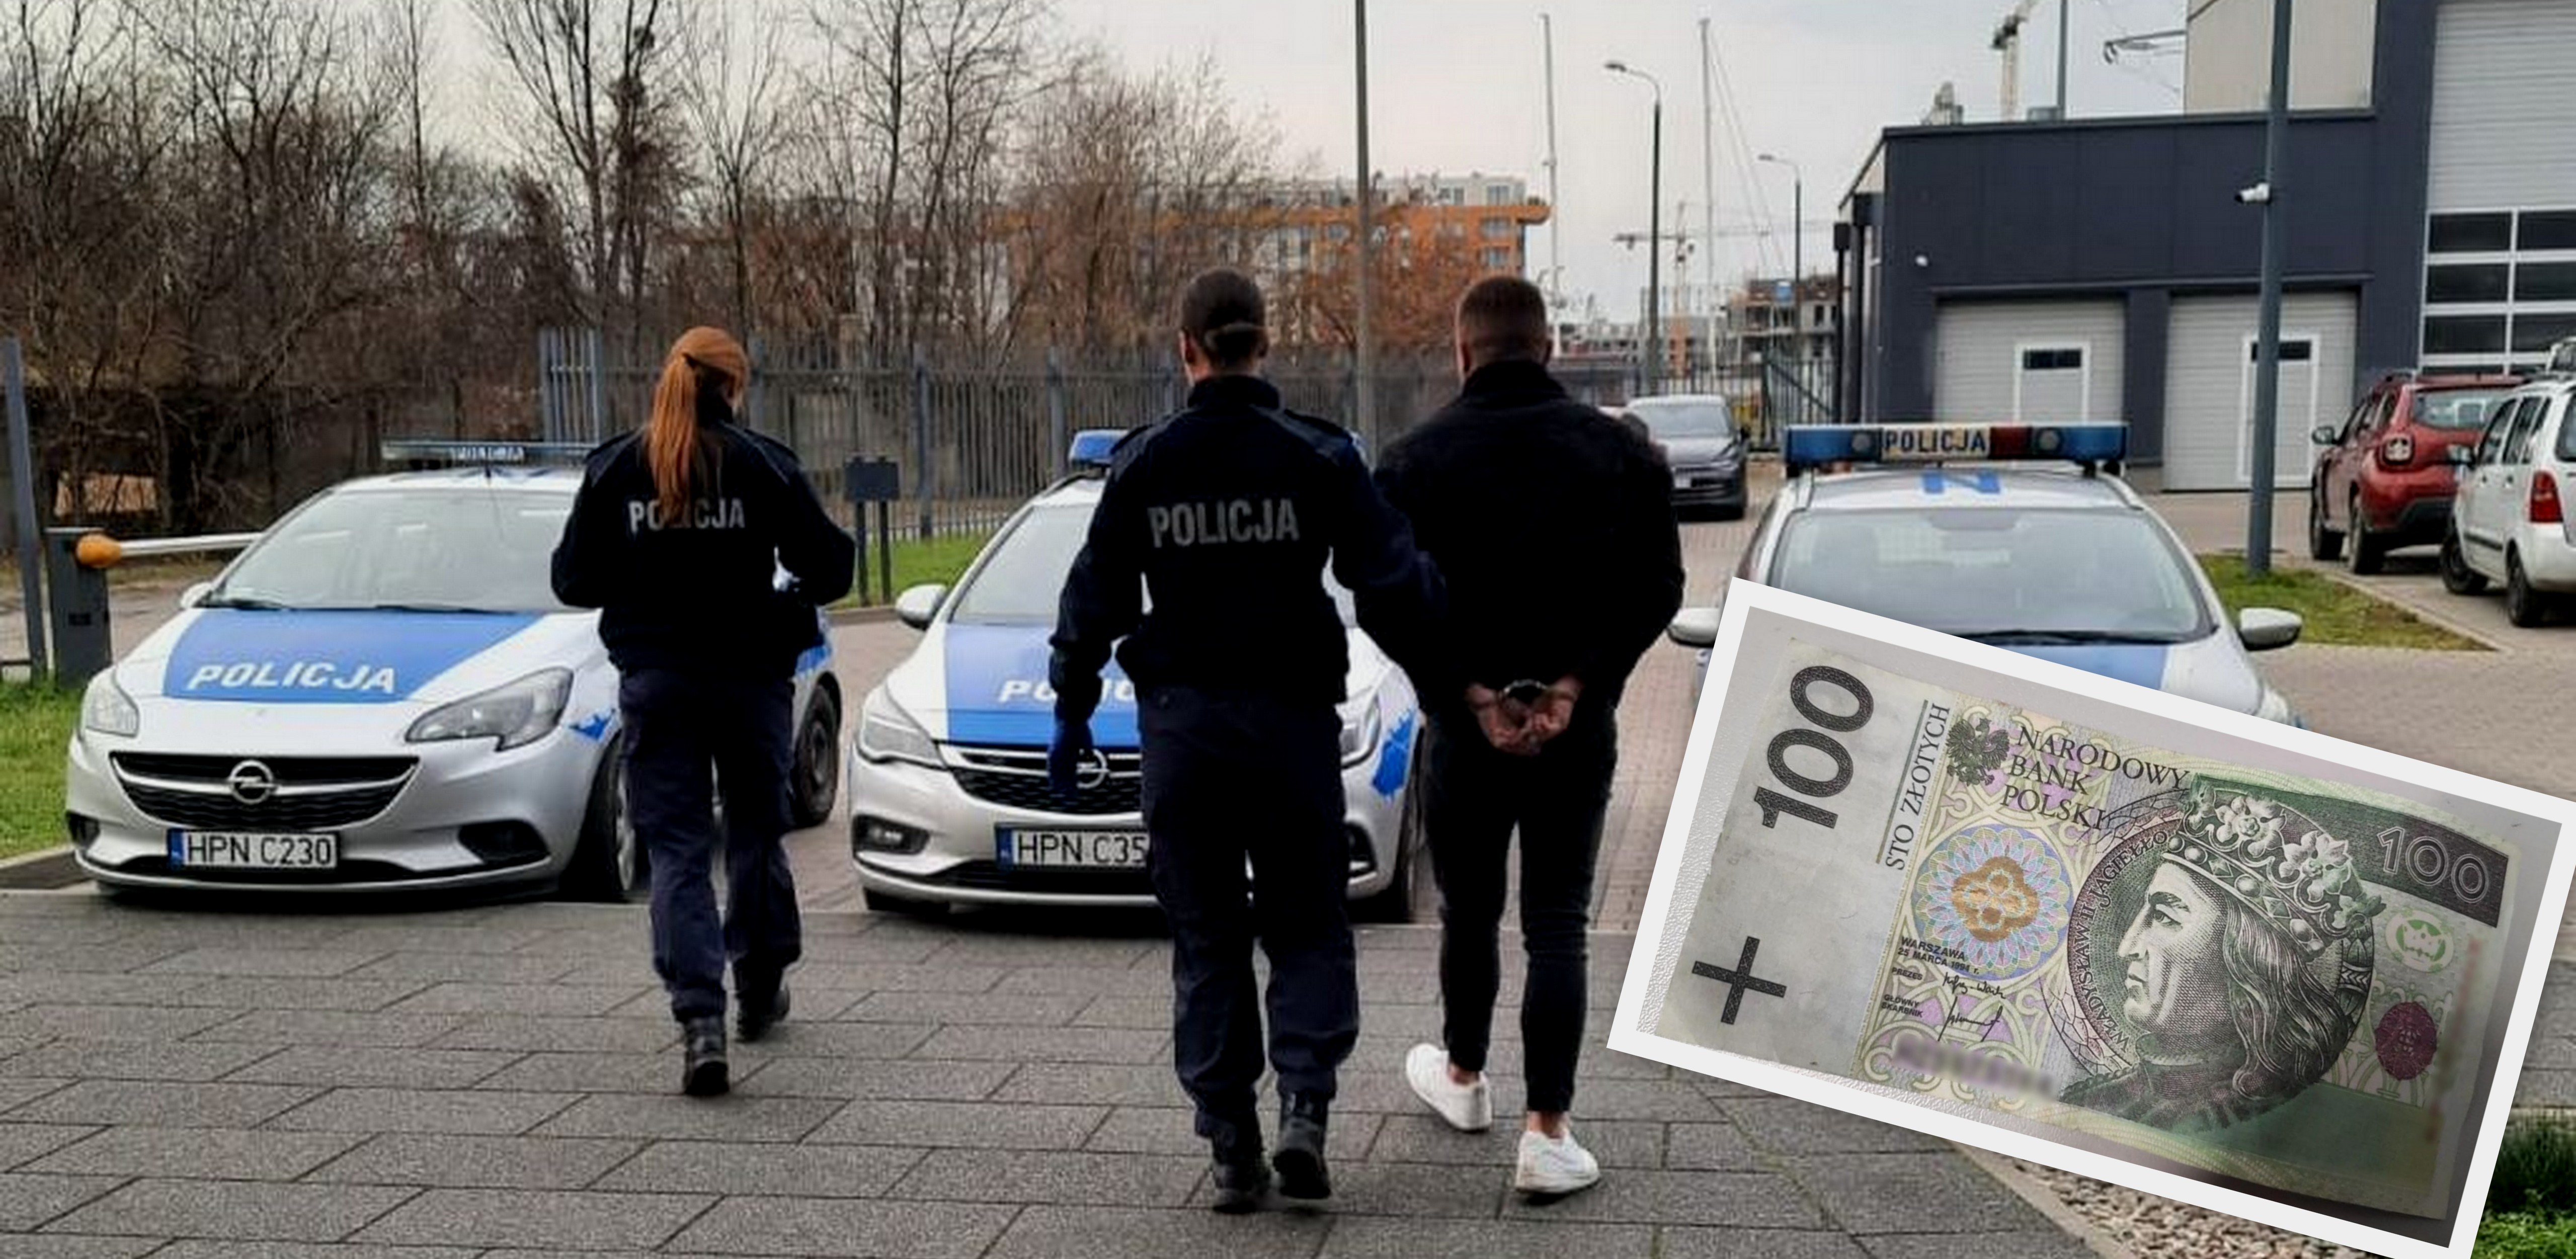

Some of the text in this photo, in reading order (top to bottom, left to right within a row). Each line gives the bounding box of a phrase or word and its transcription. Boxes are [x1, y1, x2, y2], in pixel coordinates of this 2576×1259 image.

[1885, 429, 1986, 453] POLICJA
[1921, 468, 2001, 494] N
[628, 497, 746, 534] POICJA
[1147, 498, 1300, 548] POLICJA
[186, 661, 395, 694] POLICJA
[1754, 665, 1874, 829] 100
[2018, 726, 2190, 790] NARODOWY
[1885, 703, 1951, 871] STO ZŁOTYCH
[2008, 754, 2091, 795] BANK
[2000, 784, 2107, 830] POLSKI
[188, 834, 332, 865] HPN C230
[1018, 833, 1082, 863] HPN
[2377, 826, 2489, 903] 100
[2088, 831, 2167, 908] JAGIEŁŁO
[1897, 947, 1910, 957] 25
[1912, 951, 1948, 966] MARCA
[1951, 961, 1970, 972] 1994
[1901, 937, 1965, 960] WARSZAWA
[1892, 967, 1923, 980] PREZES
[1881, 1002, 1923, 1018] SKARBNIK
